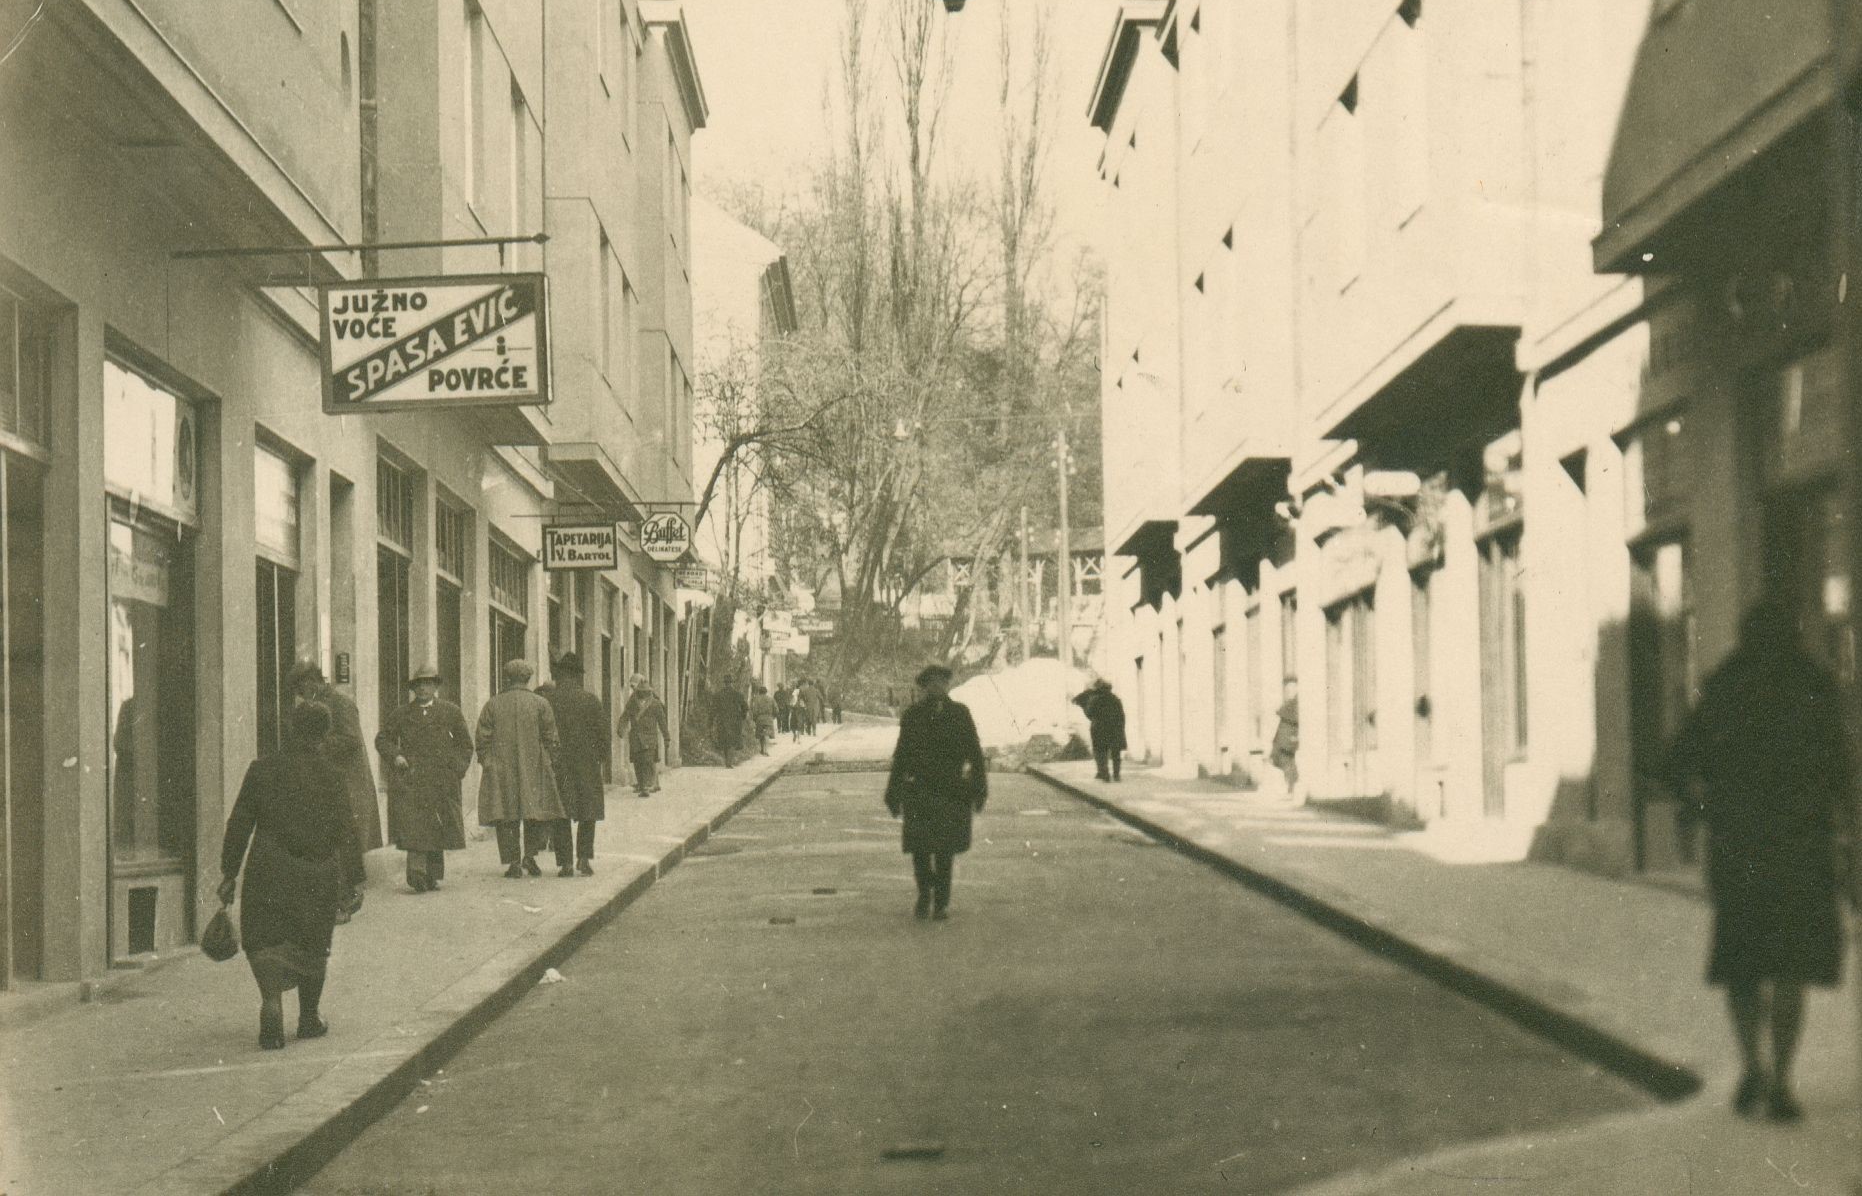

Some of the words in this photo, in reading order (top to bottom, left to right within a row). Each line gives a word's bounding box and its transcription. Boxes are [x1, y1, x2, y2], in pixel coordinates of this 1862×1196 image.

[332, 290, 428, 315] JUŽNO
[332, 312, 397, 340] VOĆE
[428, 359, 528, 392] POVRĆE
[643, 516, 686, 546] Buffet
